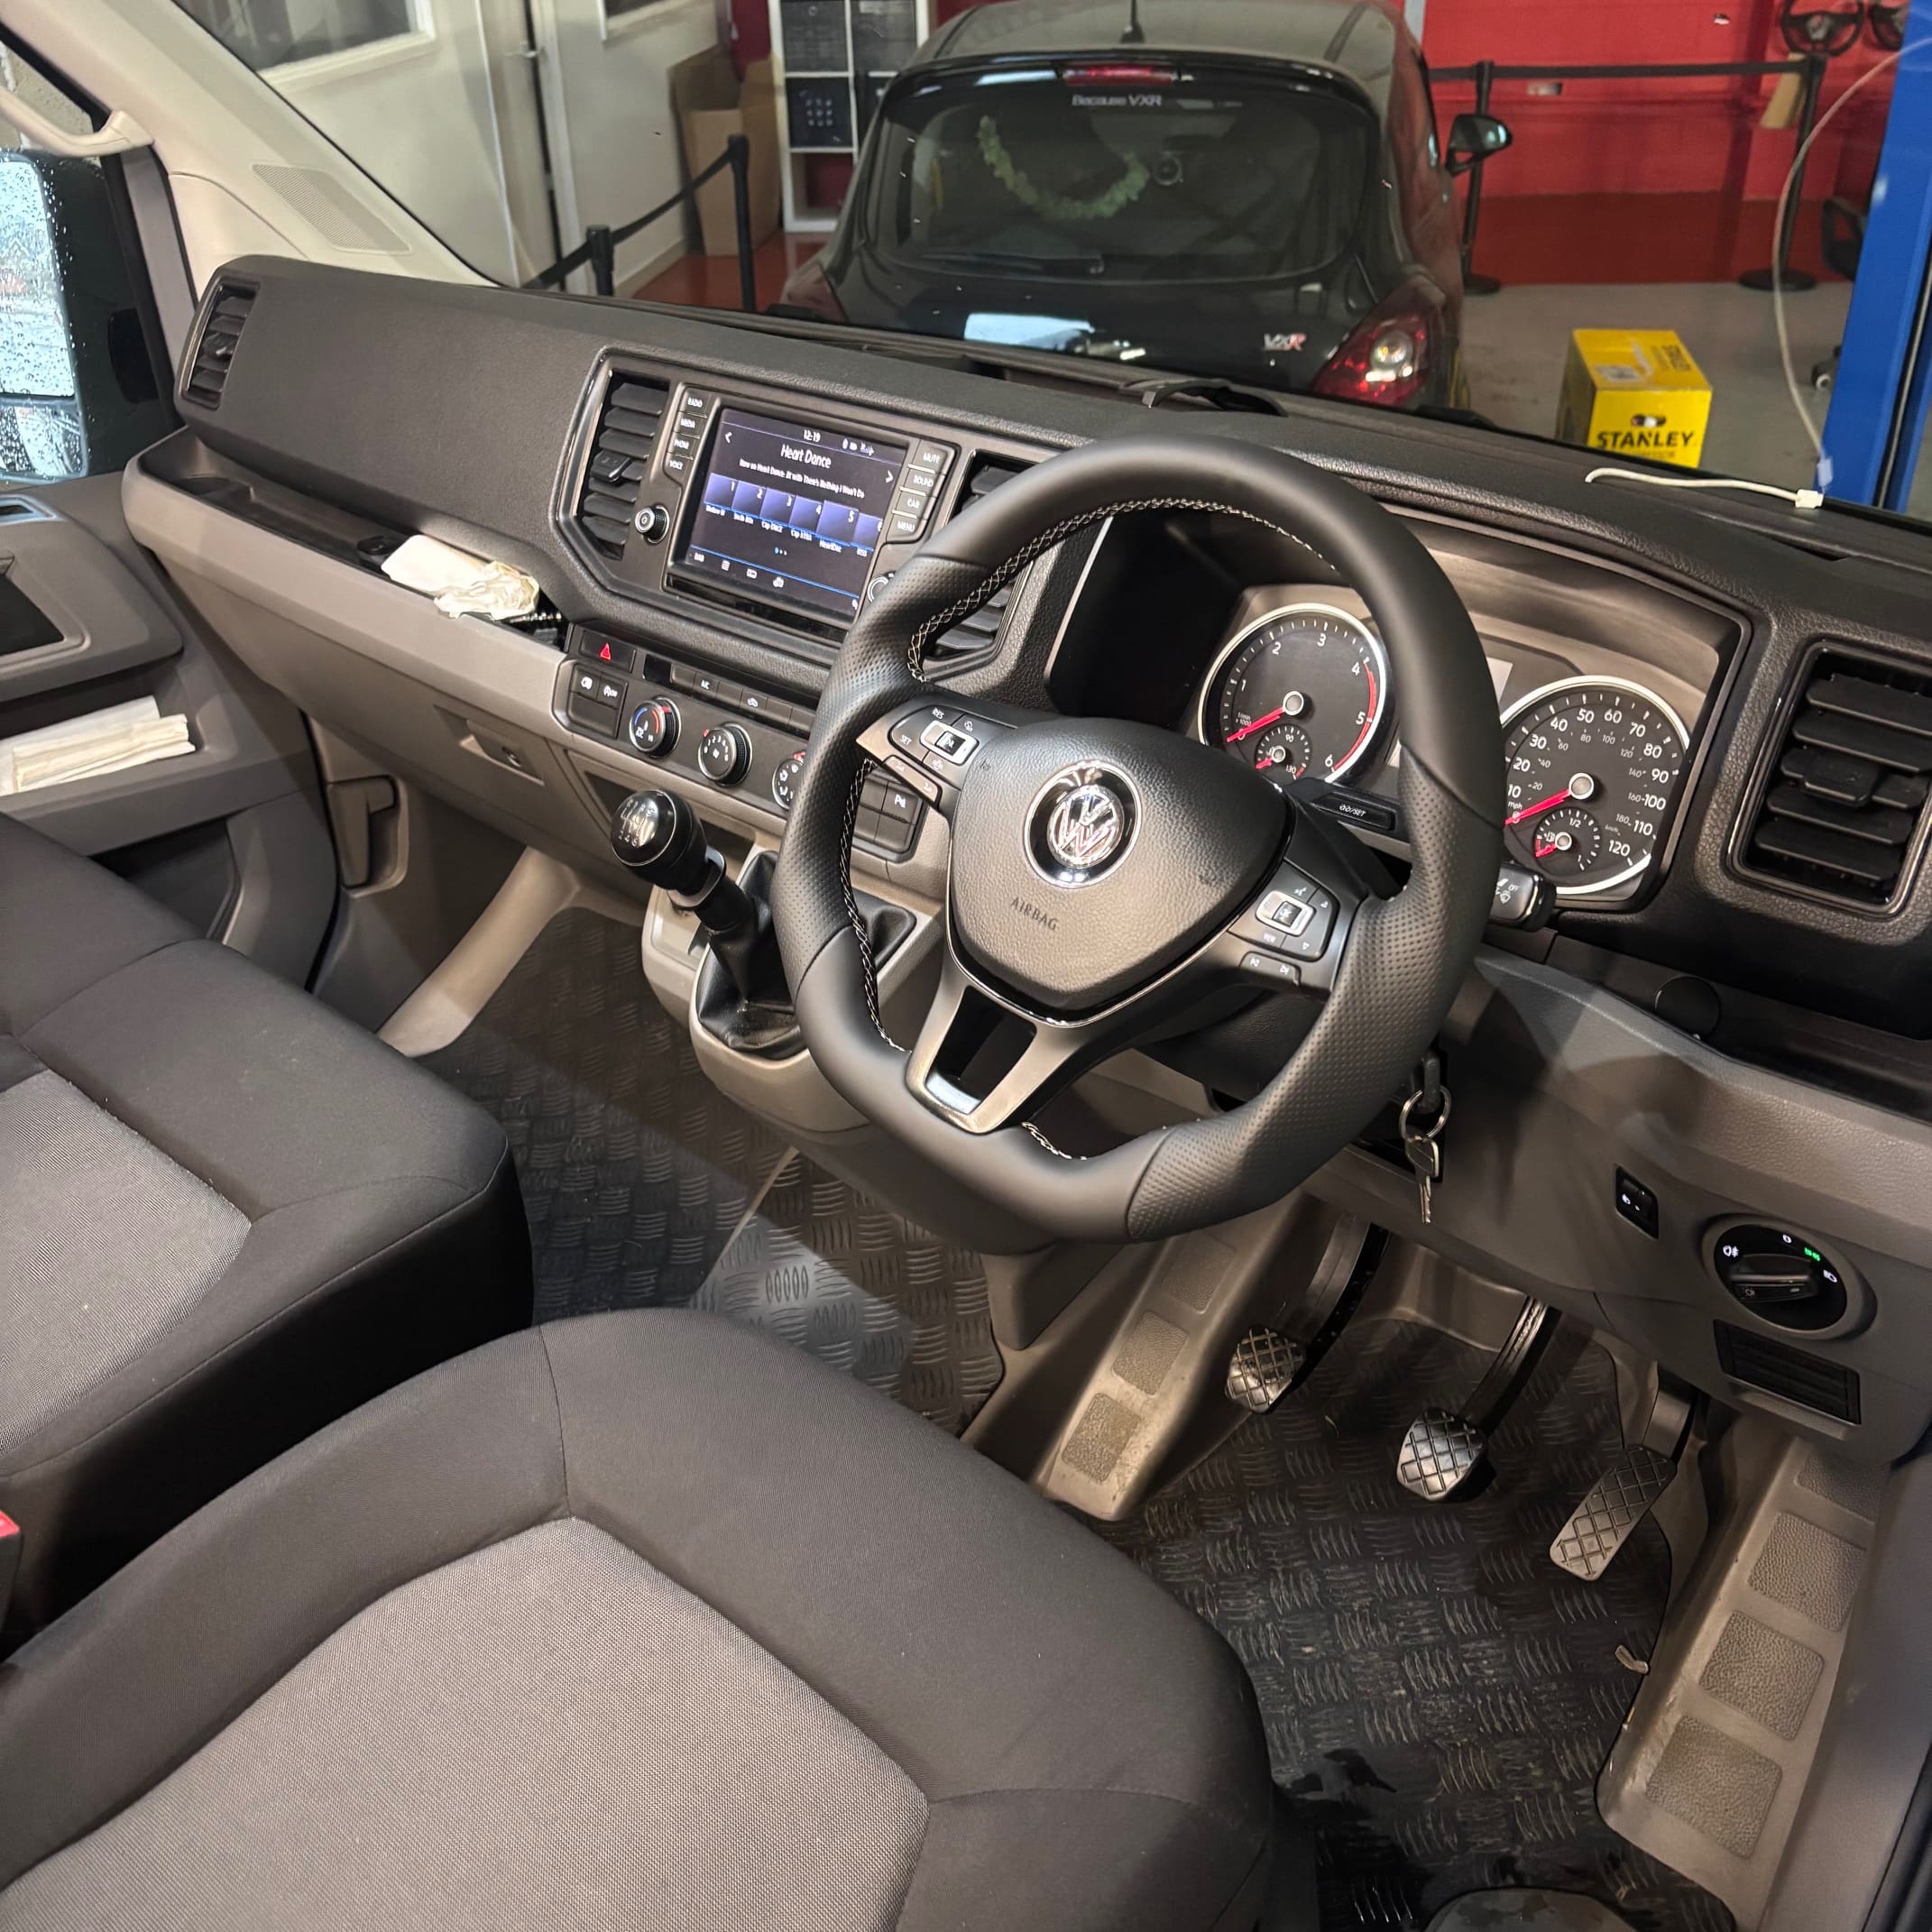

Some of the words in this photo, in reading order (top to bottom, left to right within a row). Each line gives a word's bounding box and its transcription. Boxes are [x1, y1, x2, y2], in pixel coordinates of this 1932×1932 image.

[1072, 94, 1127, 106] Because
[1128, 94, 1162, 106] VXR
[1264, 333, 1306, 351] VXR
[687, 397, 704, 408] RADIO
[1596, 430, 1695, 448] STANLEY
[780, 444, 805, 462] Heart
[804, 449, 832, 469] Dance
[923, 452, 940, 464] MUTE
[731, 482, 735, 492] 1
[913, 474, 934, 487] SOUND
[757, 488, 763, 499] 2
[787, 495, 792, 507] 3
[907, 498, 920, 509] CAR
[815, 504, 822, 515] 4
[848, 509, 855, 523] 5
[897, 520, 915, 533] MENU
[1318, 633, 1326, 647] 3
[1272, 642, 1281, 655] 2
[1351, 661, 1360, 676] 4
[1241, 679, 1247, 692] 1
[932, 707, 945, 720] RES
[1356, 711, 1366, 725] 5
[1577, 707, 1595, 723] 50
[1604, 708, 1623, 723] 60
[1550, 716, 1569, 732] 40
[1629, 722, 1646, 737] 70
[900, 734, 913, 746] SET
[1285, 734, 1294, 742] 90
[1529, 733, 1547, 750] 30
[1580, 733, 1592, 743] 80
[1602, 734, 1615, 745] 100
[1558, 742, 1569, 751] 60
[1642, 742, 1662, 759] 80
[1620, 749, 1633, 759] 120
[1325, 754, 1333, 768] 6
[1513, 756, 1531, 772] 20
[1540, 760, 1551, 768] 40
[1285, 765, 1297, 775] 130
[1628, 767, 1642, 778] 140
[1651, 768, 1670, 784] 90
[1507, 784, 1522, 798] 10
[1532, 781, 1543, 791] 20
[1627, 792, 1642, 803] 160
[1643, 793, 1667, 811] 100
[1507, 801, 1523, 811] mph
[1569, 817, 1582, 829] 1/2
[1615, 813, 1630, 824] 180
[1633, 819, 1653, 836] 110
[1608, 839, 1631, 857] 120
[1578, 854, 1582, 862] 1
[1010, 897, 1059, 931] AIRBAG
